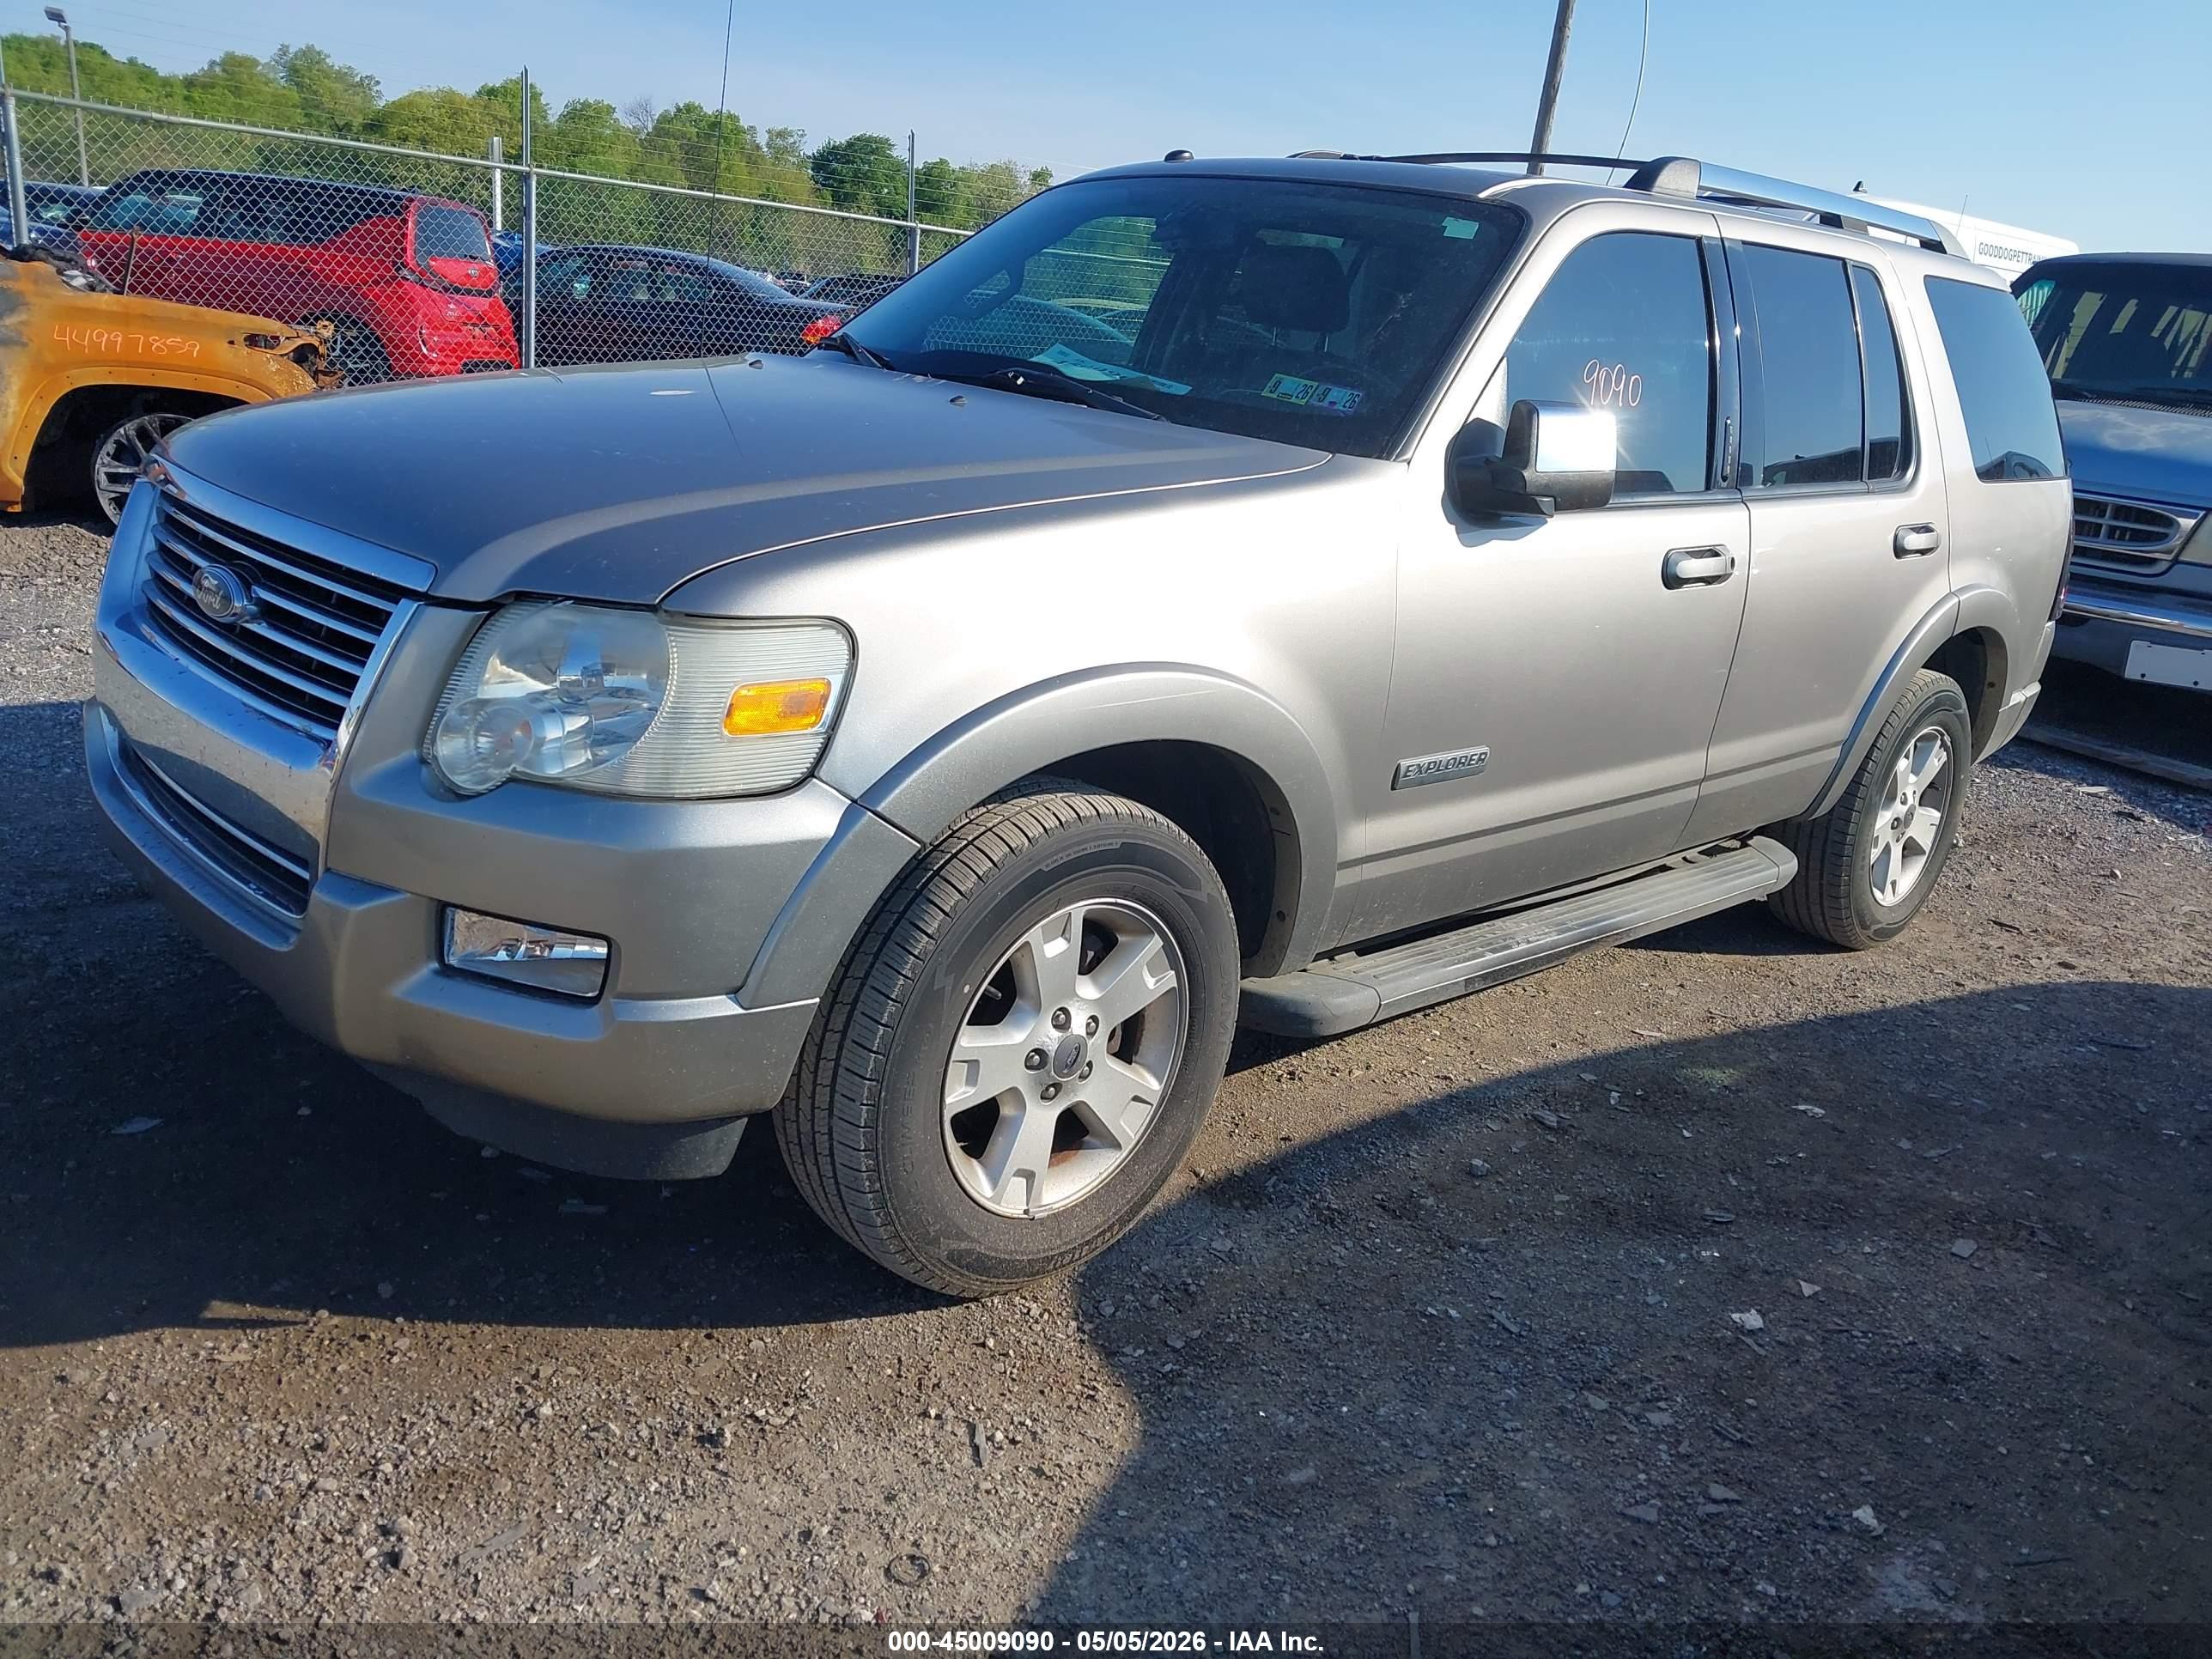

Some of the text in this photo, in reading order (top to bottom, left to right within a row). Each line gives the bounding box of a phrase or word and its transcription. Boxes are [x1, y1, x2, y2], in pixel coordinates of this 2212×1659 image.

[53, 325, 200, 357] 44997859
[1294, 383, 1315, 400] 26
[1583, 359, 1642, 406] 9090
[1318, 386, 1361, 410] 9 26
[196, 573, 223, 611] Ford
[1401, 751, 1488, 778] EXPLORER
